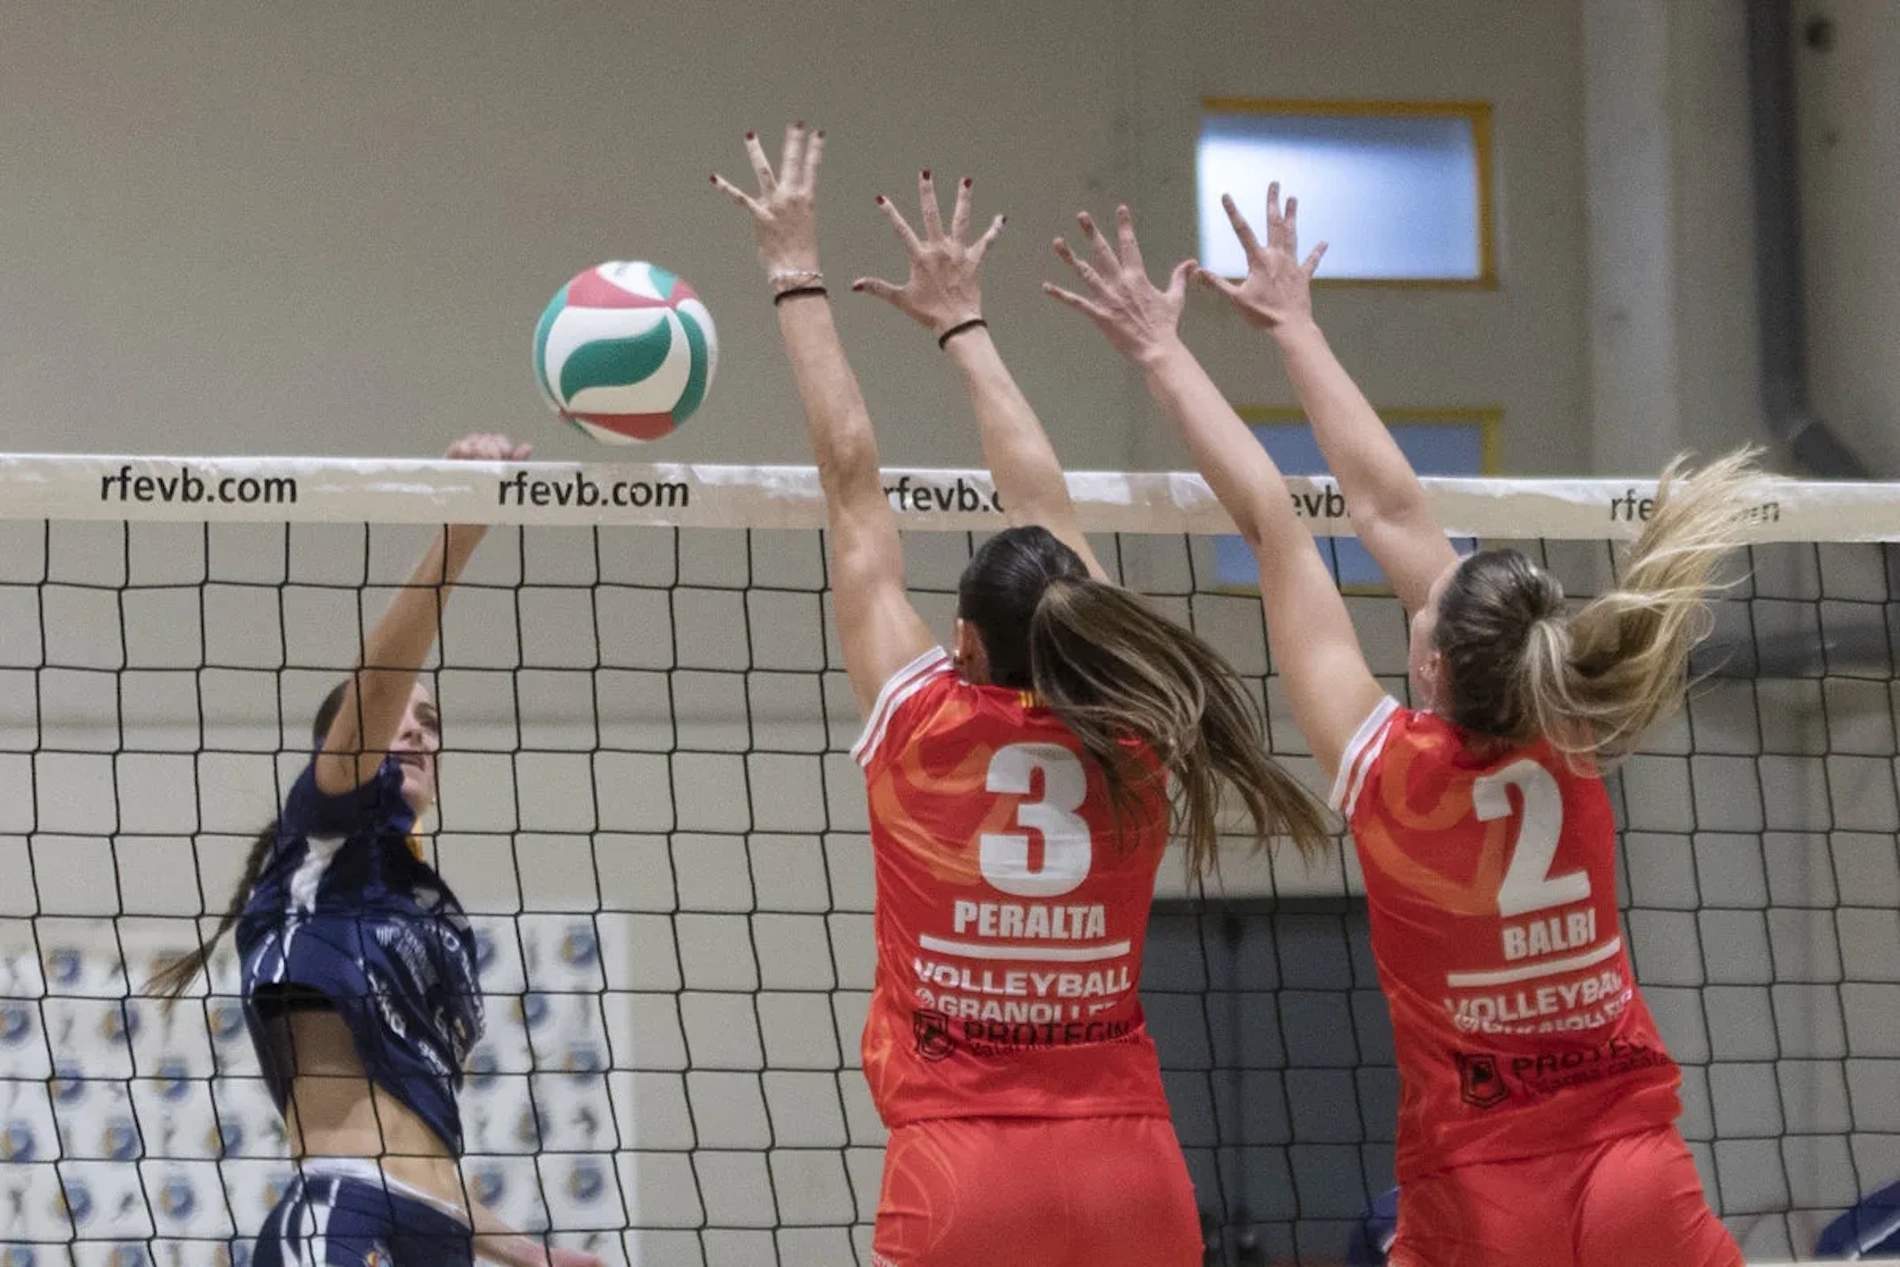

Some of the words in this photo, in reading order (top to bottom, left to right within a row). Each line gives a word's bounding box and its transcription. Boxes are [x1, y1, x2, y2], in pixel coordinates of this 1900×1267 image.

[101, 466, 298, 504] rfevb.com
[498, 471, 690, 508] rfevb.com
[979, 742, 1092, 897] 3
[1472, 758, 1591, 918] 2
[954, 900, 1106, 940] PERALTA
[1502, 907, 1596, 961] BALBI
[913, 957, 1132, 998] VOLLEYBALL
